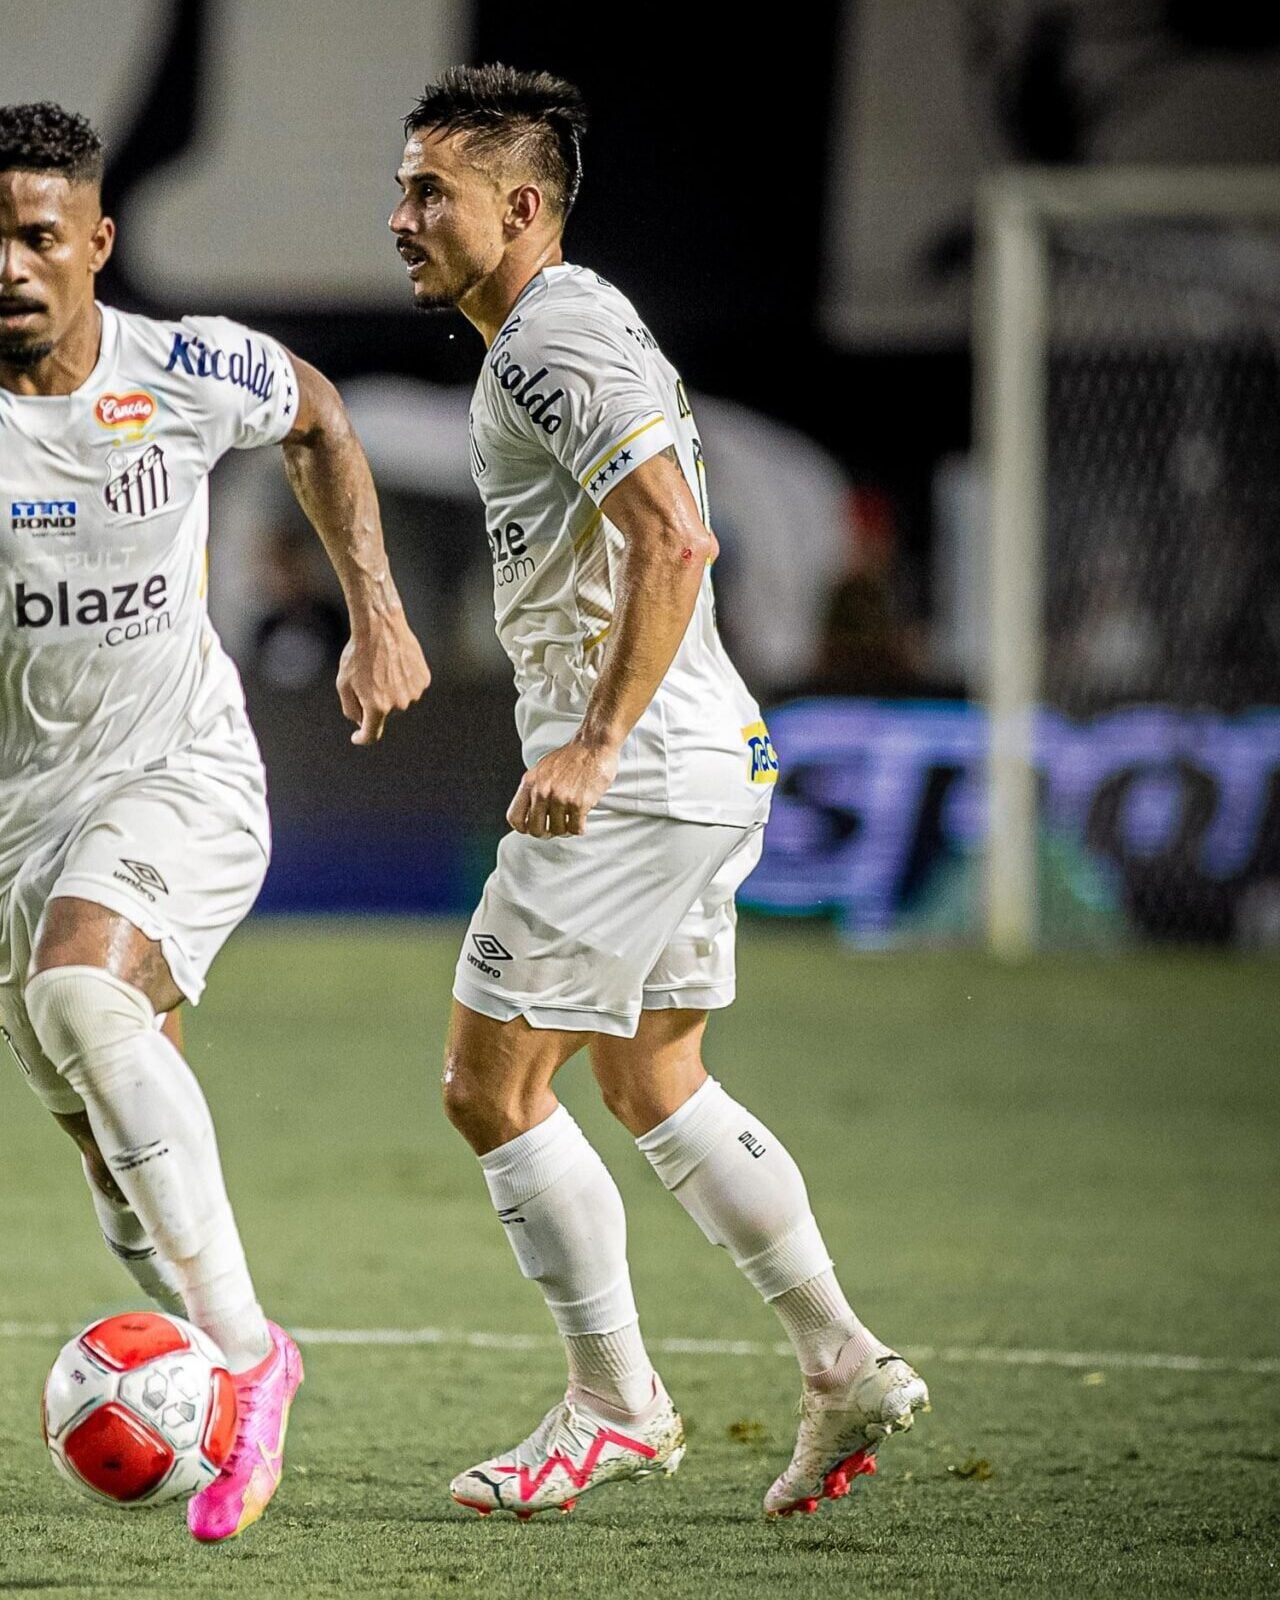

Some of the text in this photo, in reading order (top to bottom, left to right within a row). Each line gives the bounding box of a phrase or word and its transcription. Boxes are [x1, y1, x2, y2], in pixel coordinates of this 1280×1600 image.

[12, 516, 76, 530] BOND
[15, 573, 167, 628] blaze
[98, 611, 171, 648] .com
[112, 871, 156, 902] umbro
[467, 952, 501, 978] umbro
